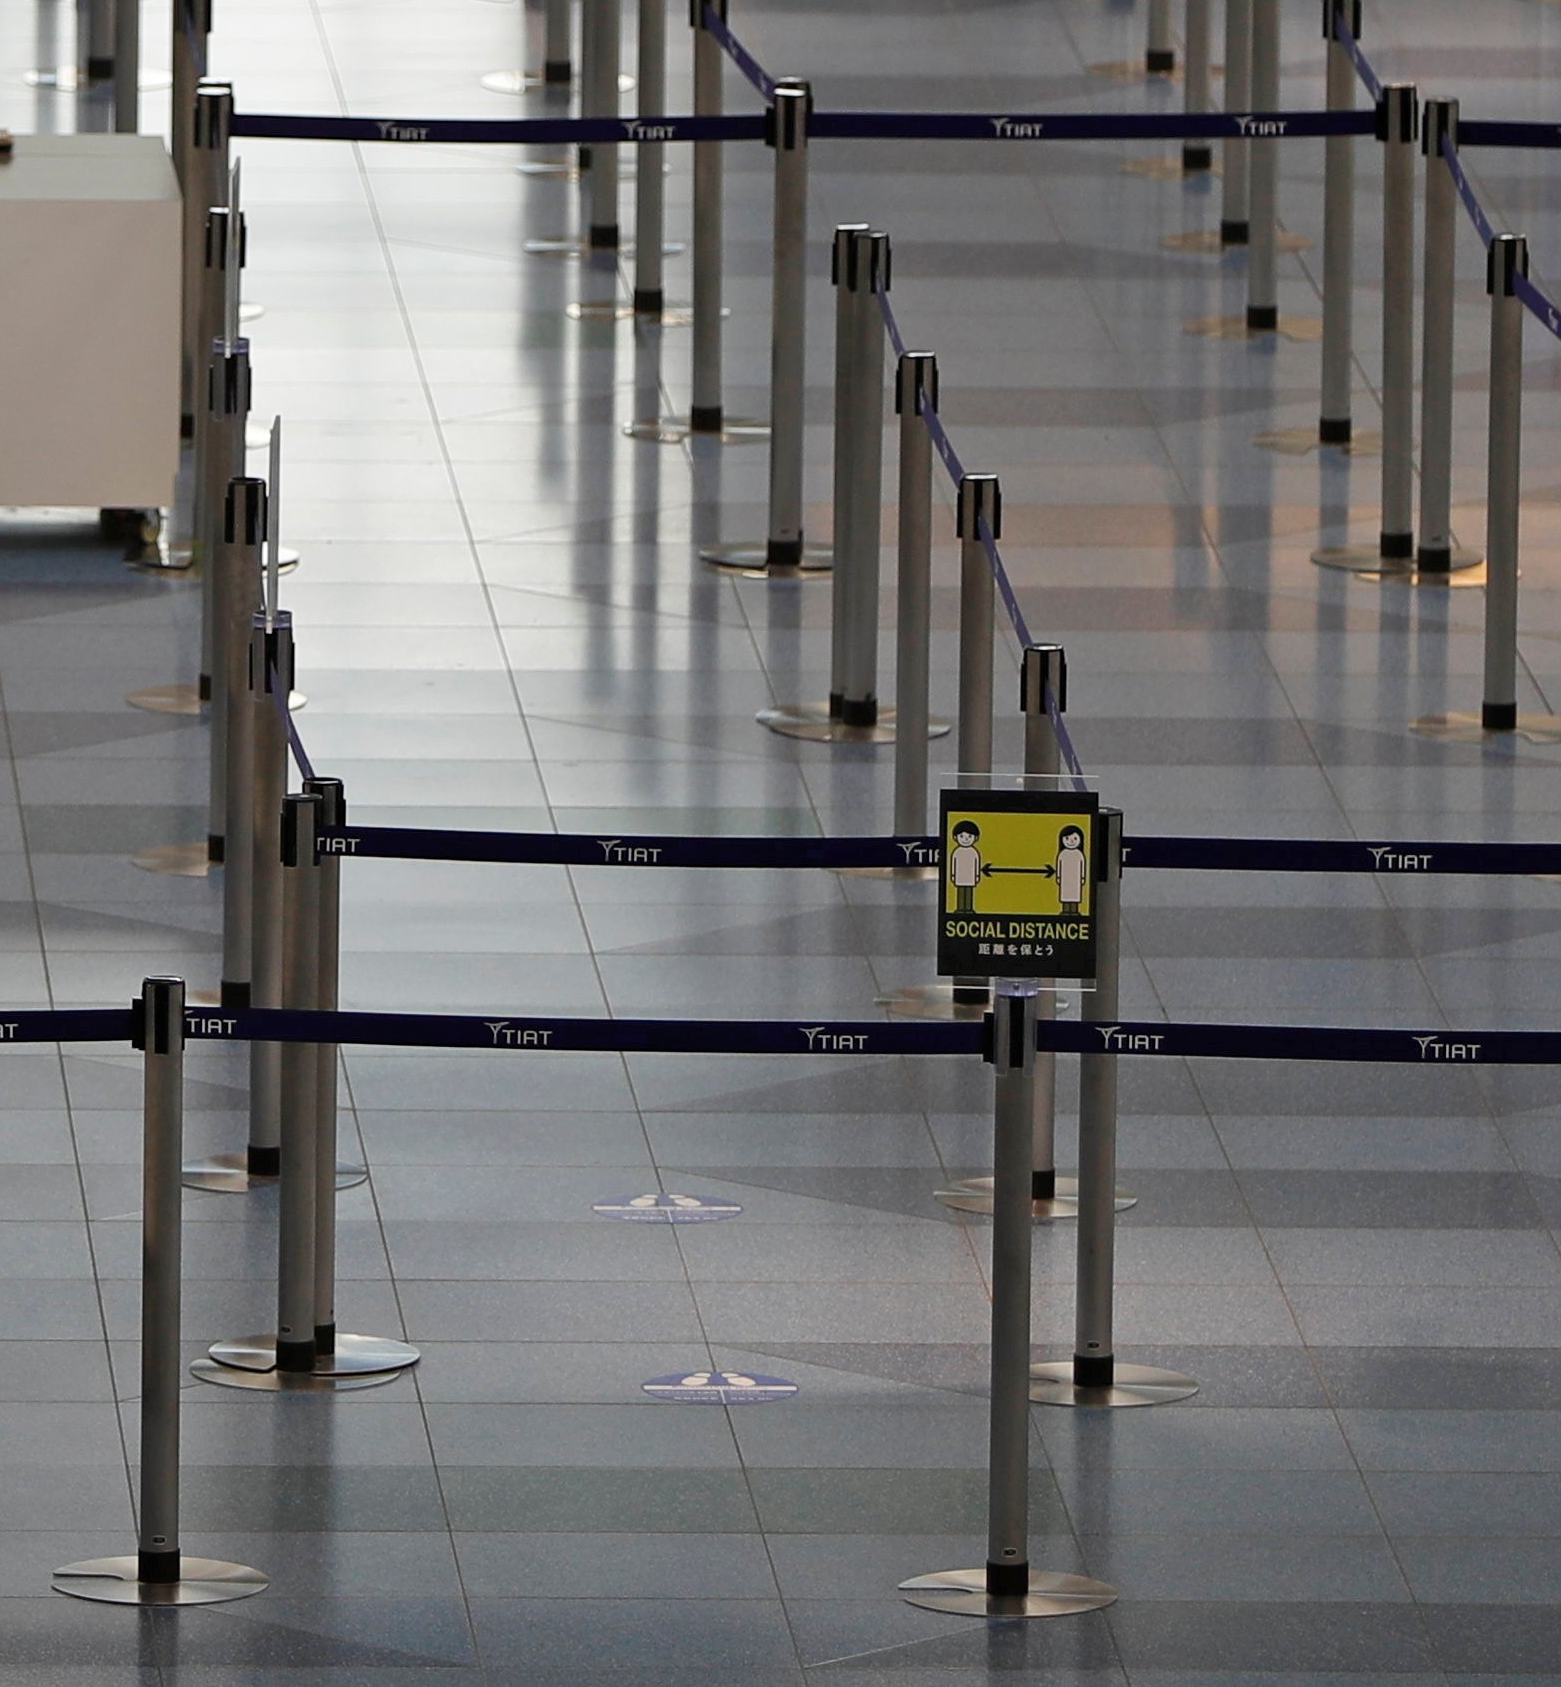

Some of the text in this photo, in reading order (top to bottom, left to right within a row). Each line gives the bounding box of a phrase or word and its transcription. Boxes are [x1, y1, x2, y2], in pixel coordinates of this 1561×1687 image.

[614, 845, 662, 862] TIAT
[945, 920, 1090, 940] SOCIAL DISTANCE
[978, 943, 1055, 956] 距離を保とう
[816, 1032, 869, 1049] TIAT
[1113, 1033, 1165, 1050] TIAT
